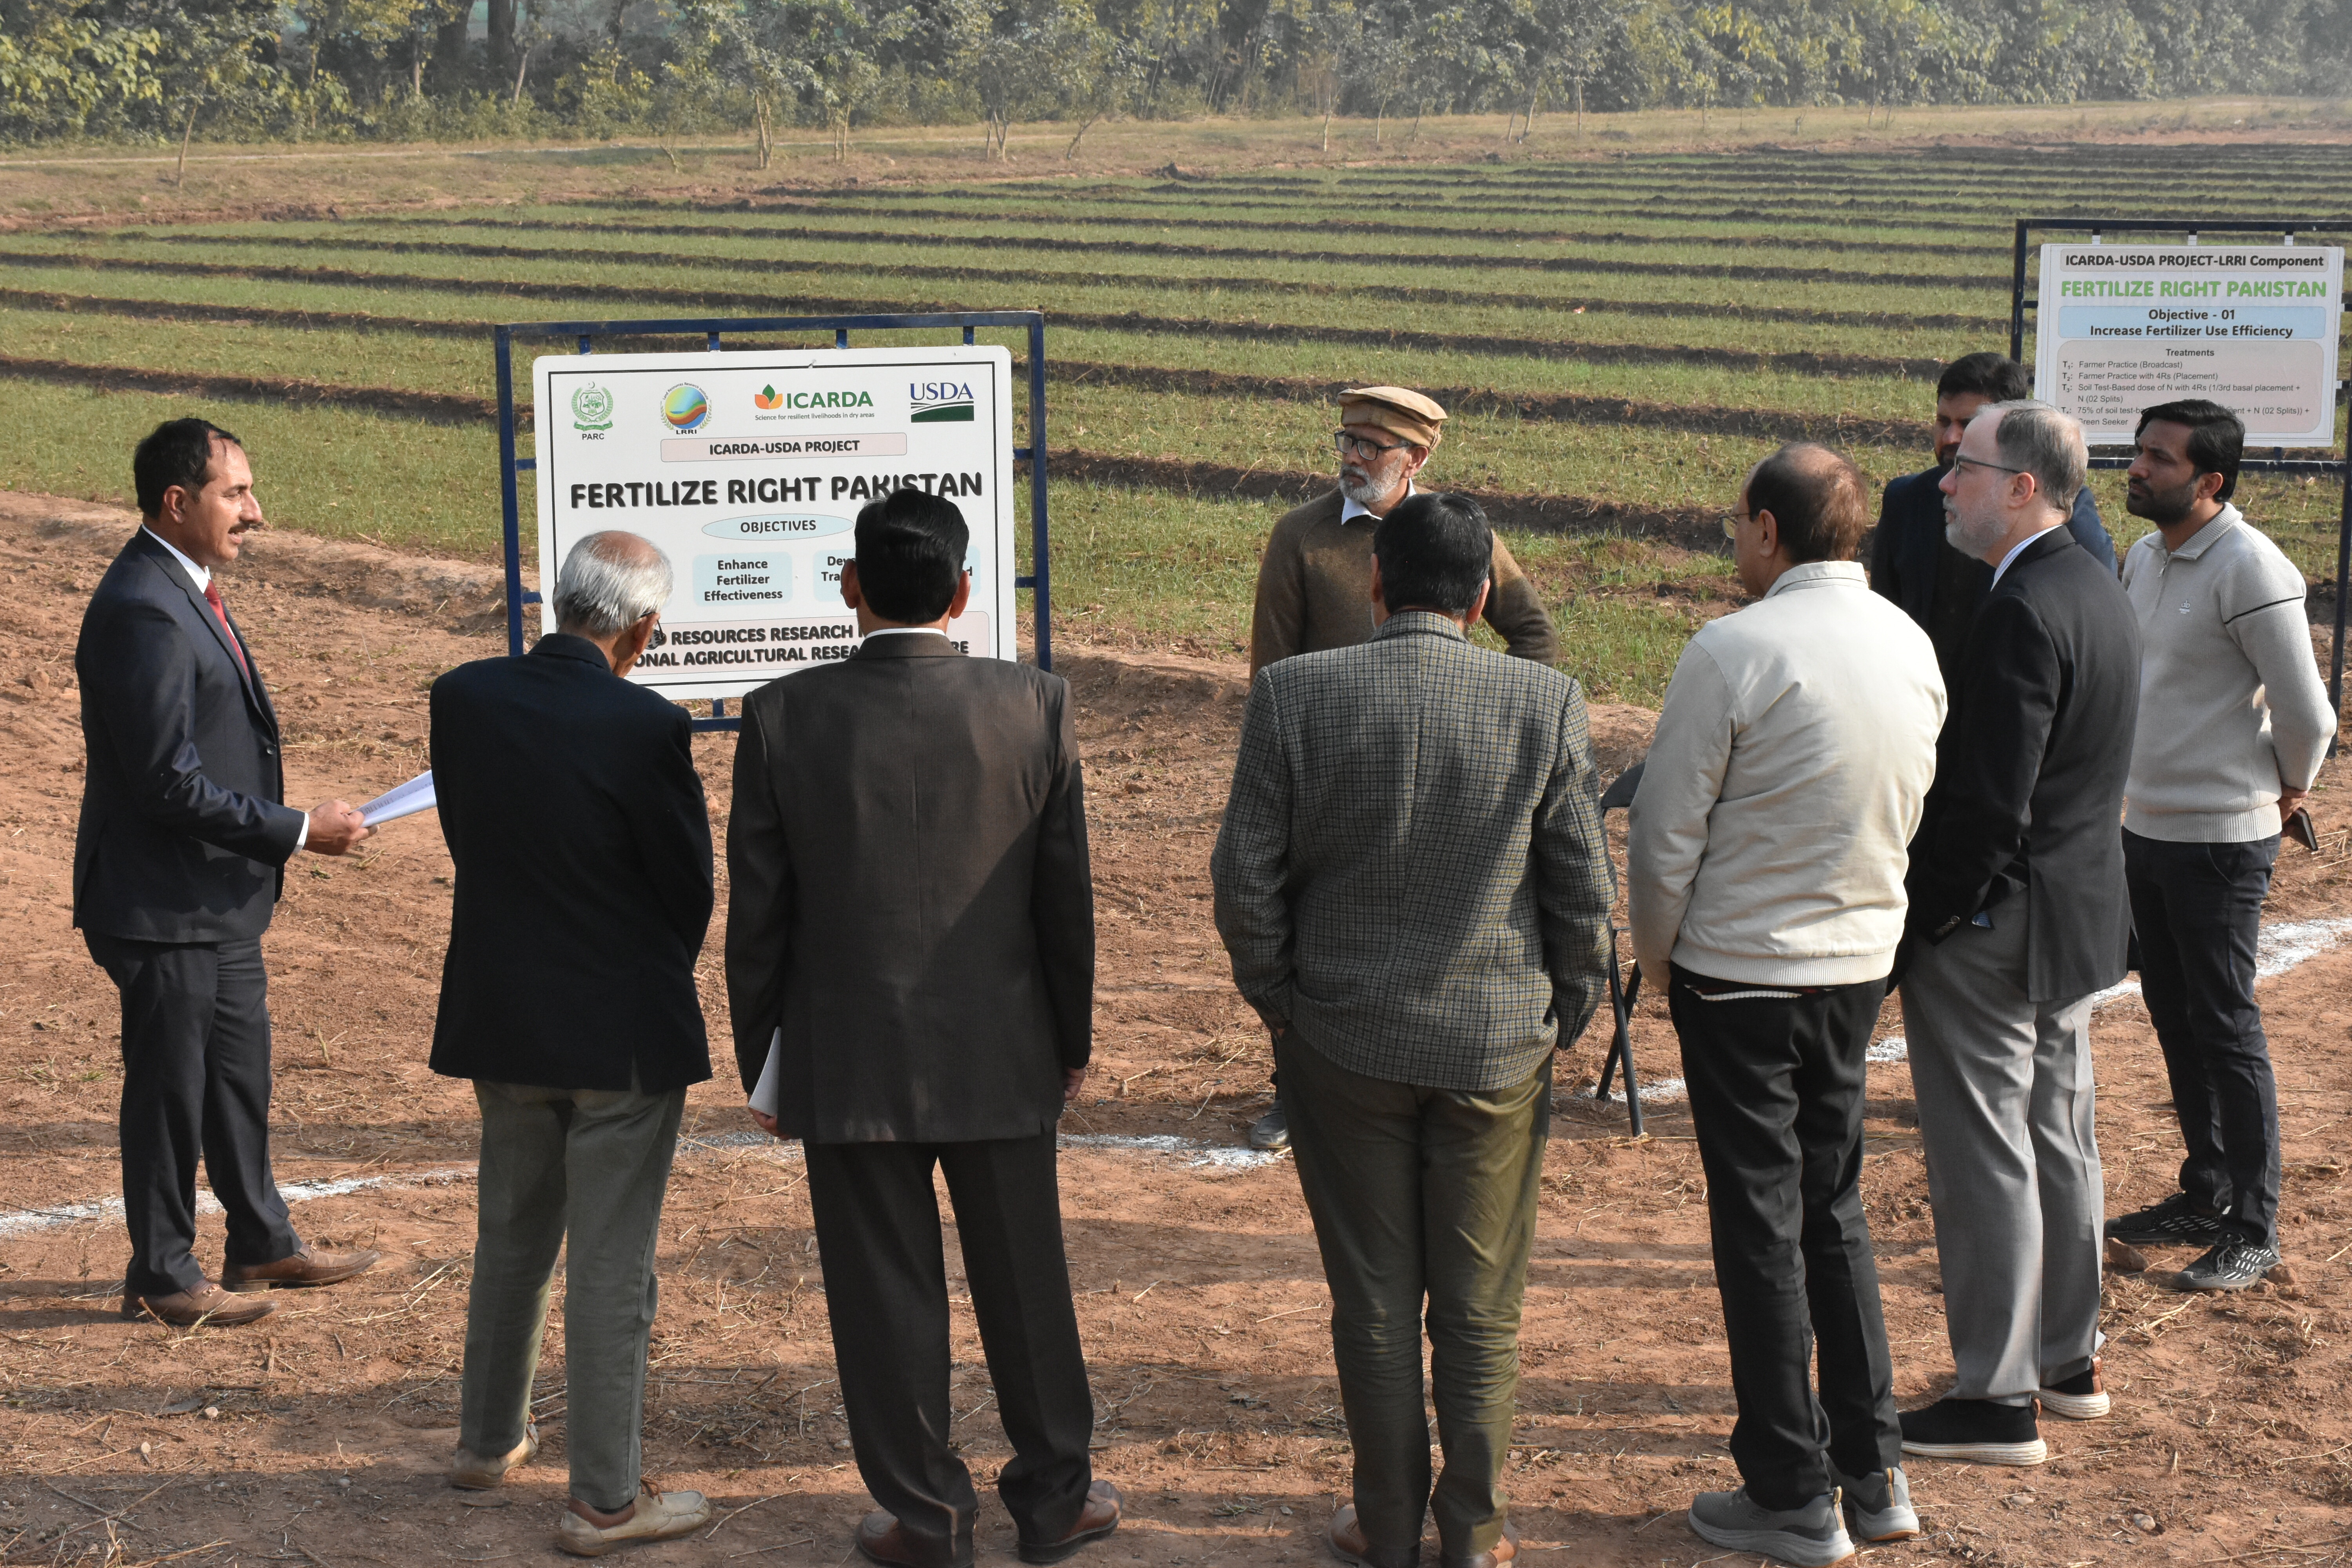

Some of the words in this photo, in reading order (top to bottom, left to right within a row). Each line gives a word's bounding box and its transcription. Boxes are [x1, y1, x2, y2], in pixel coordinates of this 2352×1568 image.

[2066, 255, 2155, 266] ICARDA-USDA
[2159, 255, 2246, 267] PROJECT-LRRI
[2250, 255, 2324, 269] Component
[2061, 281, 2154, 297] FERTILIZE
[2160, 281, 2221, 297] RIGHT
[2227, 281, 2326, 297] PAKISTAN
[2149, 309, 2208, 322] Objective
[2221, 309, 2234, 320] 01
[2091, 325, 2142, 336] Increase
[2146, 325, 2201, 336] Fertilizer
[2206, 325, 2228, 336] Use
[2232, 325, 2293, 339] Efficiency
[910, 382, 974, 400] USDA
[787, 391, 873, 409] ICARDA
[2277, 407, 2303, 416] Splits))
[710, 442, 802, 455] ICARDA-USDA
[805, 439, 860, 453] PROJECT
[571, 480, 718, 508] FERTILIZE
[728, 477, 822, 504] RIGHT
[831, 472, 982, 500] PAKISTAN
[740, 520, 816, 534] OBJECTIVES
[718, 559, 768, 570] Enhance
[717, 574, 770, 586] Fertilizer
[704, 590, 783, 601] Effectiveness
[671, 628, 766, 645] RESOURCES
[770, 624, 853, 641] RESEARCH
[634, 652, 680, 667] ONAL
[683, 646, 808, 666] AGRICULTURAL
[811, 645, 859, 660] RESEA
